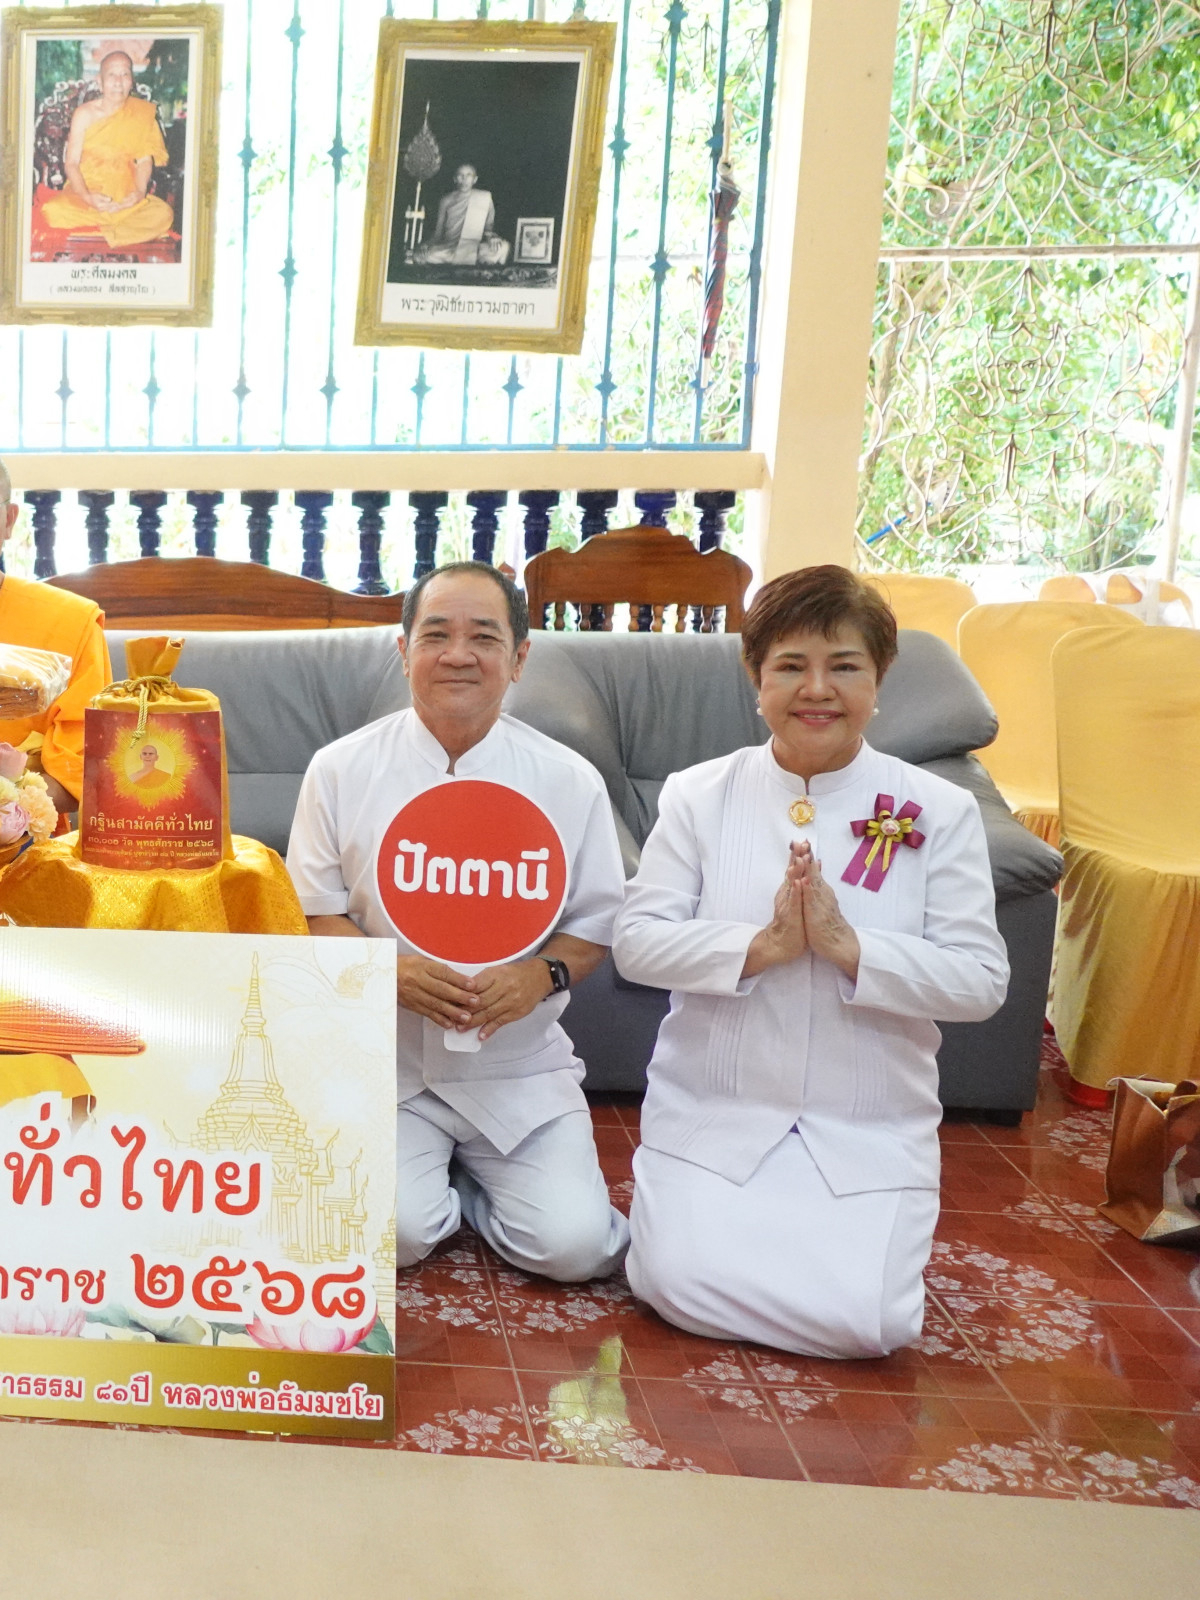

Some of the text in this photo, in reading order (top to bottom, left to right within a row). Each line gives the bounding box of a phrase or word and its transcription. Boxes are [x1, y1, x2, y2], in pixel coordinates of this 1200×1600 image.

[88, 812, 214, 832] กฐินสามัคคีทั่วไทย
[393, 838, 550, 901] ปัตตานี
[130, 1253, 366, 1320] ๒๕๖๘
[96, 1372, 150, 1403] ๘๑ปี
[164, 1372, 382, 1419] หลวงพ่อธัมมชโย
